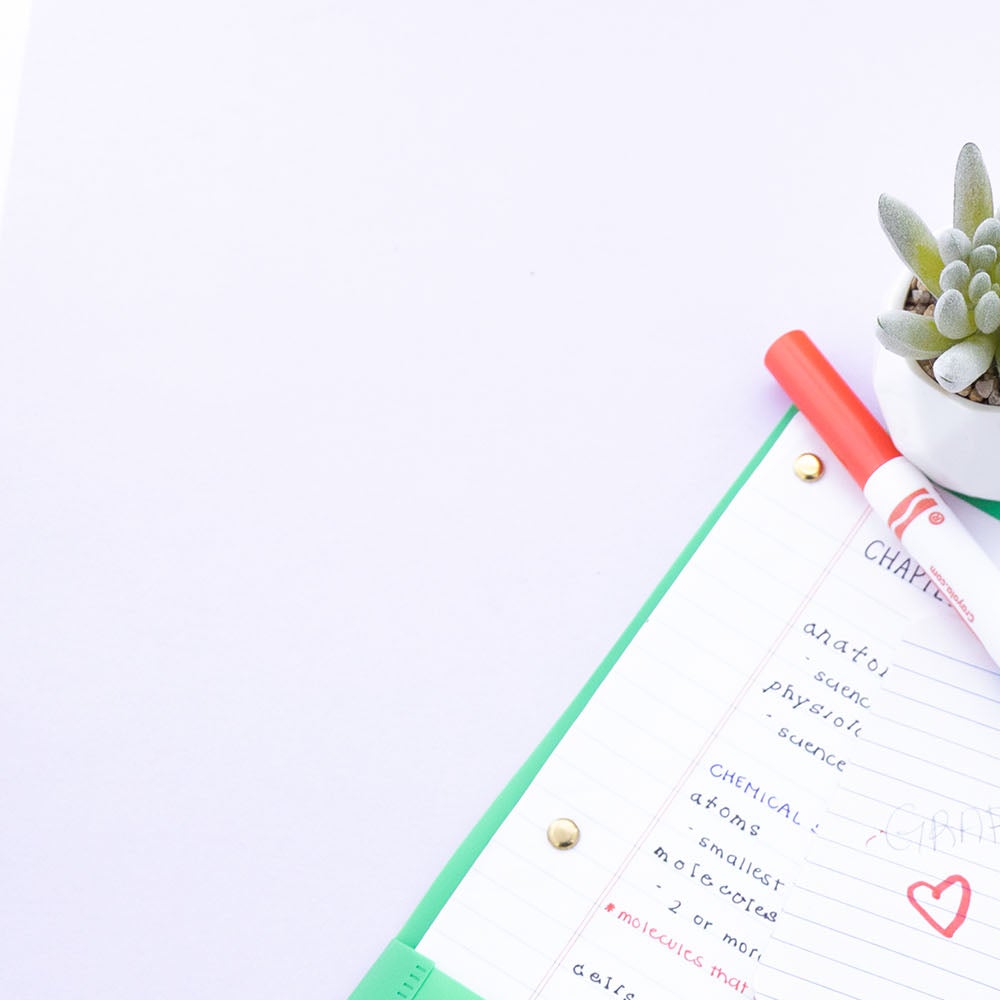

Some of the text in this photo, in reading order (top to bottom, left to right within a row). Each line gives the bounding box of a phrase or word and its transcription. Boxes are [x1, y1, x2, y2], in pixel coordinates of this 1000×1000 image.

[864, 539, 952, 608] CHAPT
[777, 727, 847, 772] science
[690, 792, 761, 836] atoms
[709, 763, 801, 826] CHEMICAL
[698, 836, 785, 891] smallest
[668, 899, 682, 914] 2
[693, 914, 713, 930] or
[710, 965, 749, 994] that
